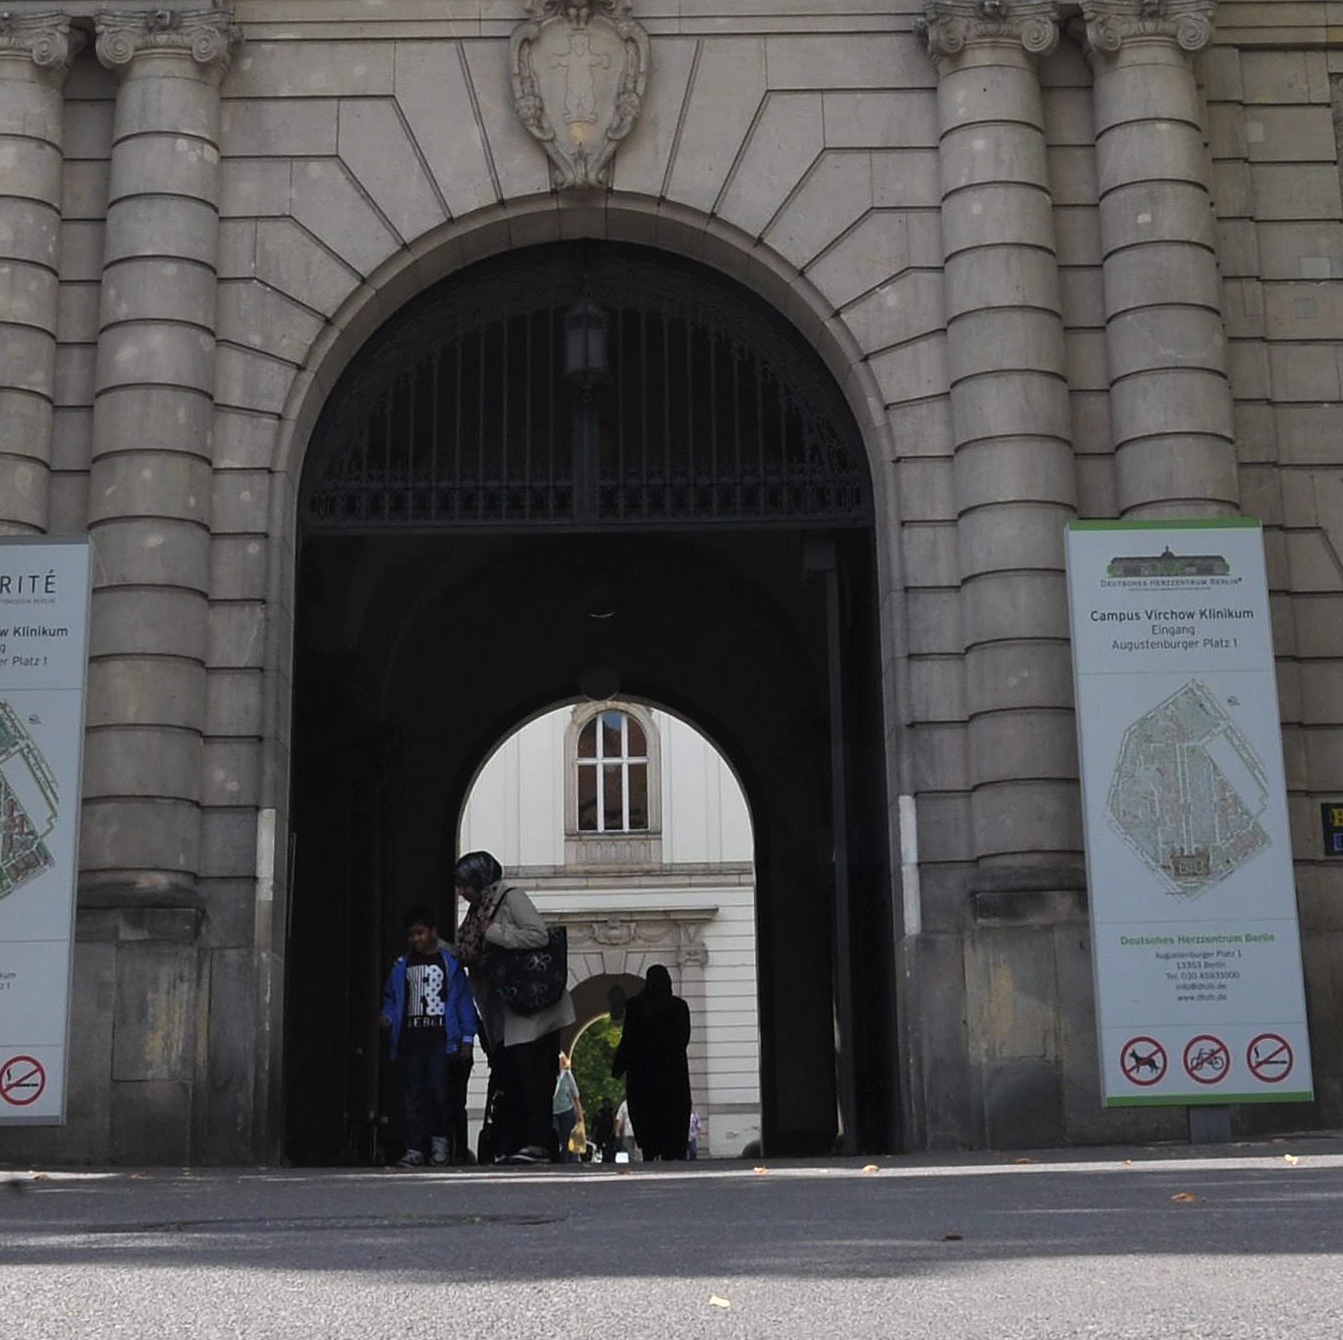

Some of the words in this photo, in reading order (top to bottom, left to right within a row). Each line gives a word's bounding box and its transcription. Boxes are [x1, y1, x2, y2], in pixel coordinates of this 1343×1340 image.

[1090, 610, 1141, 623] Campus
[1144, 609, 1195, 620] Virchow
[1199, 608, 1254, 620] Klinikum
[12, 625, 69, 637] Klinikum
[1151, 624, 1196, 636] Eingang
[1112, 639, 1199, 651] Augustenburger
[1202, 638, 1230, 648] Platz
[1233, 638, 1238, 648] 1
[11, 655, 39, 666] Platz
[42, 655, 48, 666] 1
[1120, 935, 1175, 945] Deutsches
[1177, 934, 1243, 945] Herzzentrum
[1244, 933, 1276, 943] Berlin
